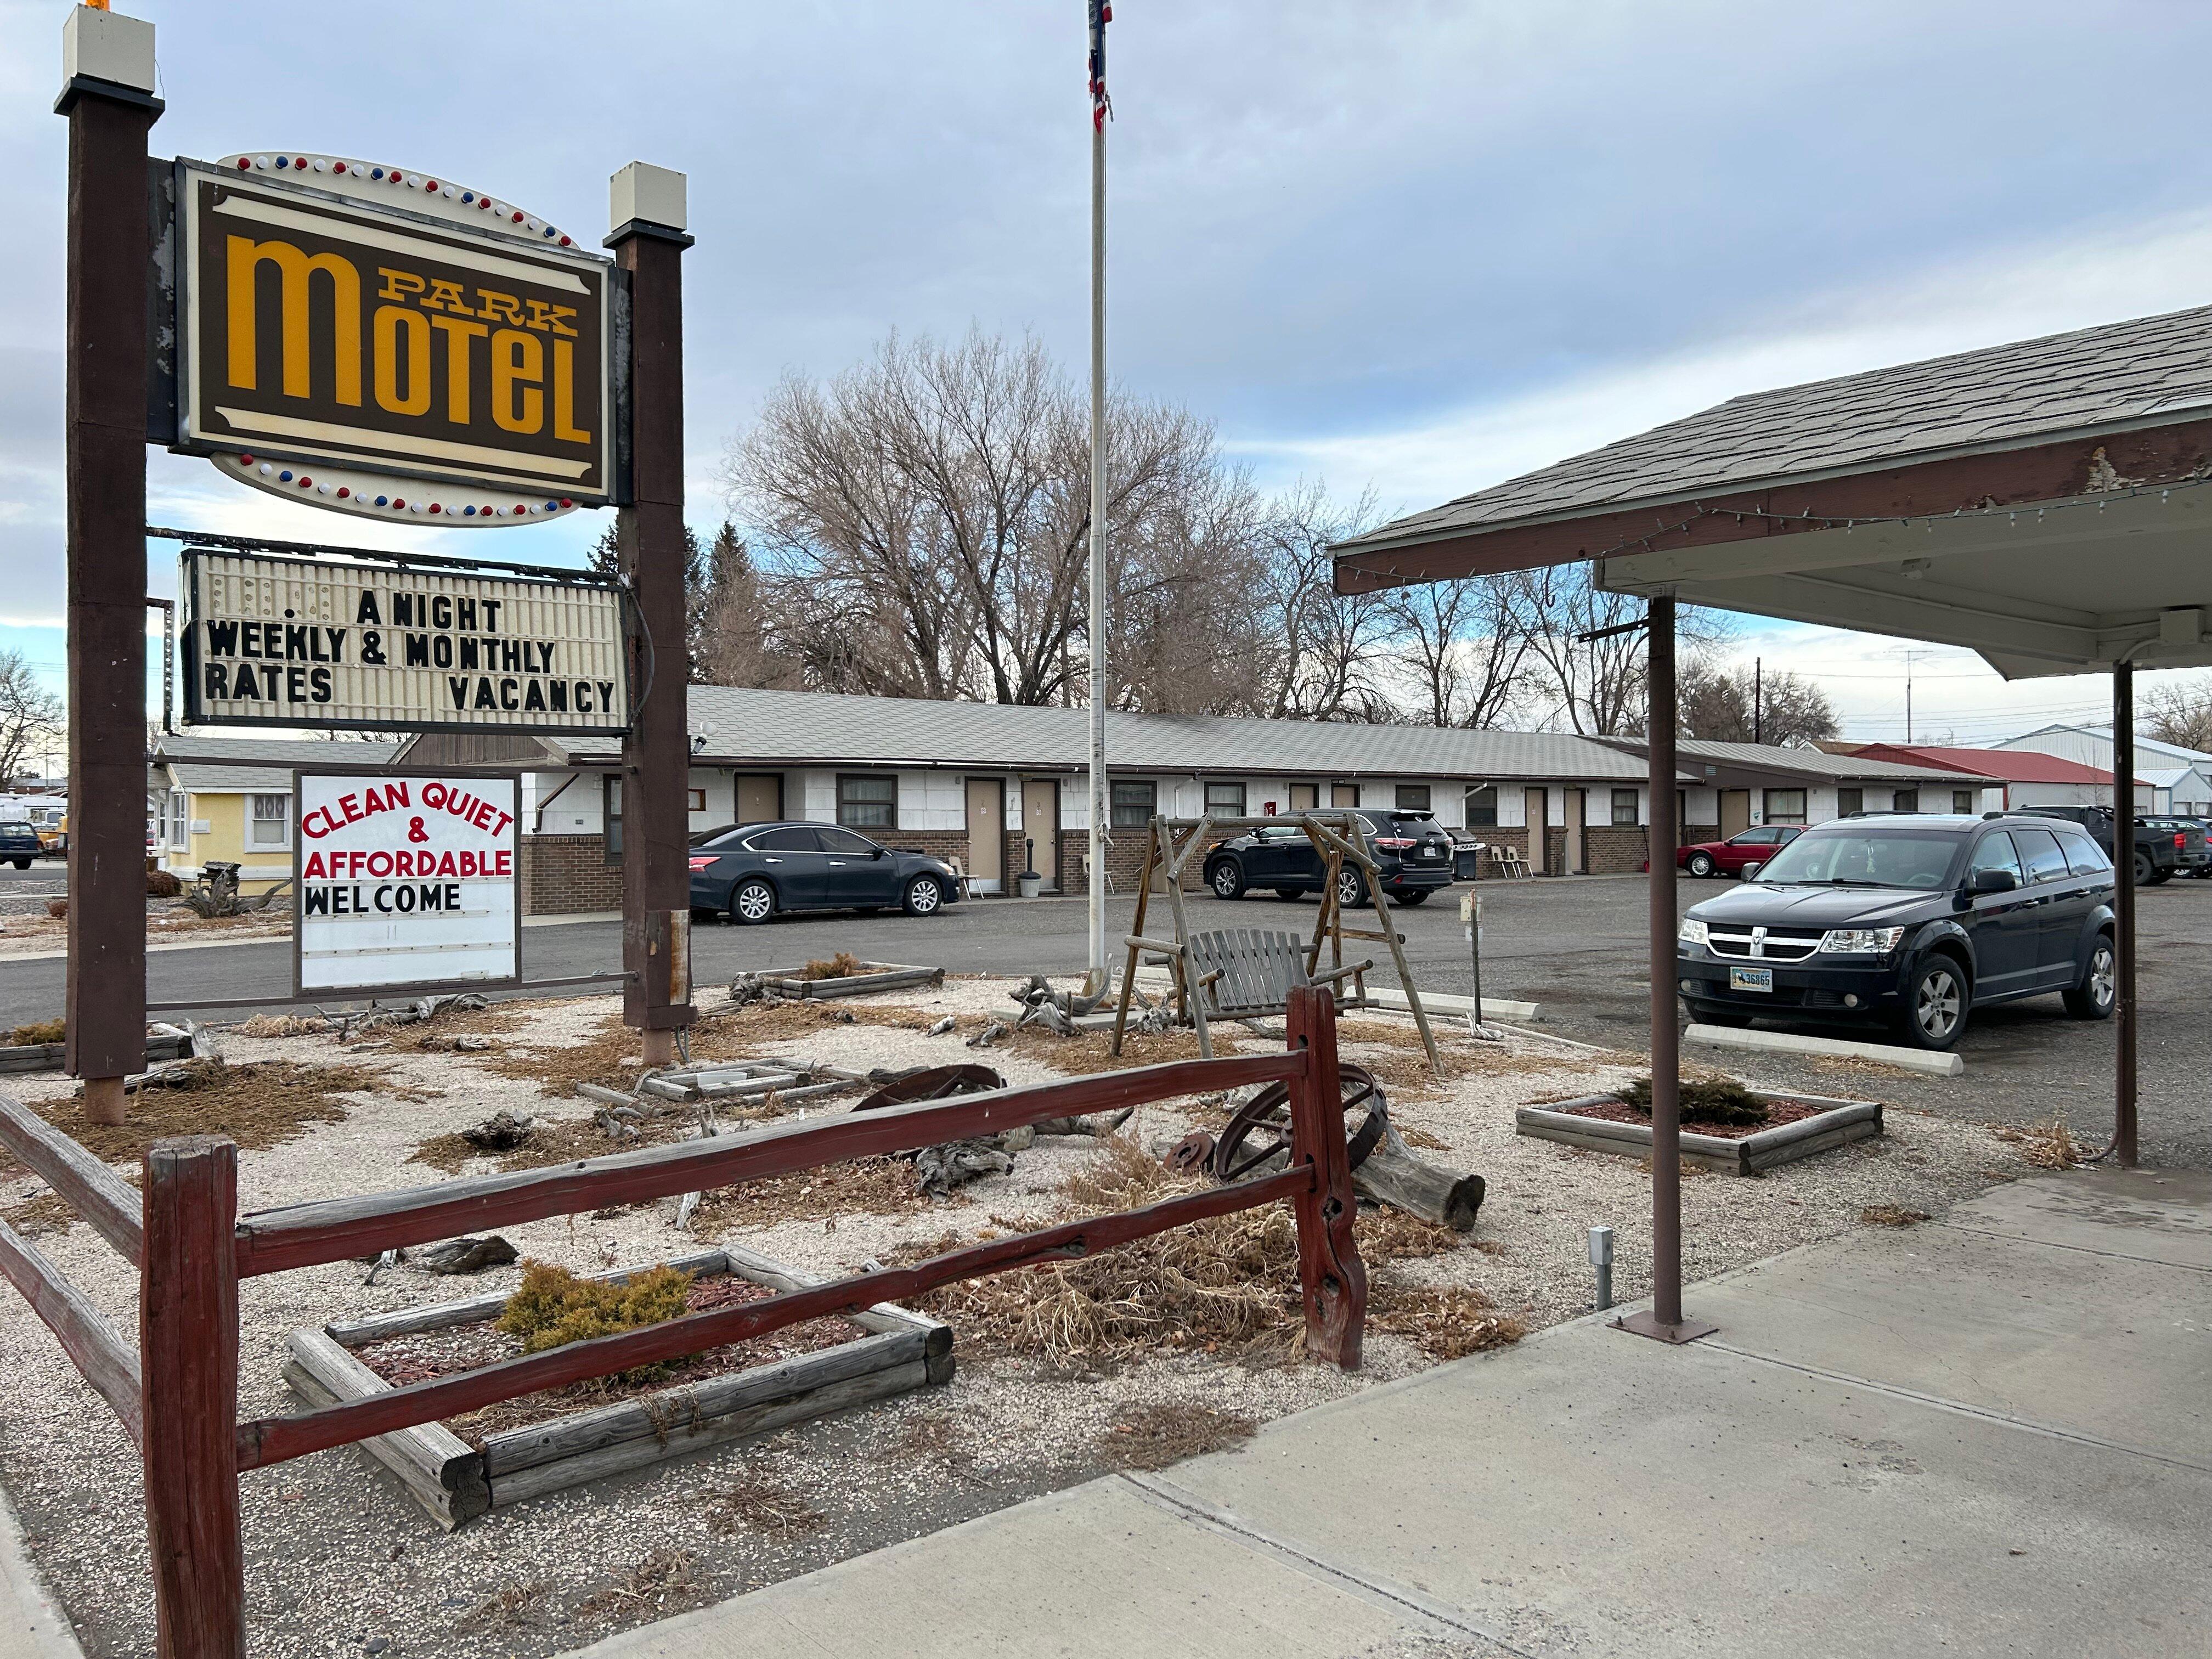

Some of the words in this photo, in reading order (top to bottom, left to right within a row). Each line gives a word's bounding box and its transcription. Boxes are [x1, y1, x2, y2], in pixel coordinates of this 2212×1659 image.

[378, 267, 578, 337] PARK
[356, 590, 382, 625] A
[393, 592, 501, 633] NIGHT
[206, 619, 347, 663] WEEKLY
[360, 630, 387, 665] &
[405, 633, 555, 674] MONTHLY
[205, 663, 331, 703] RATES
[448, 676, 614, 713] VACANCY
[302, 782, 410, 839] CLEAN
[422, 782, 514, 837] QUIET
[408, 816, 429, 843] &
[303, 850, 512, 879] AFFORDABLE
[304, 883, 460, 915] WELCOME
[1746, 974, 1770, 986] 36865
